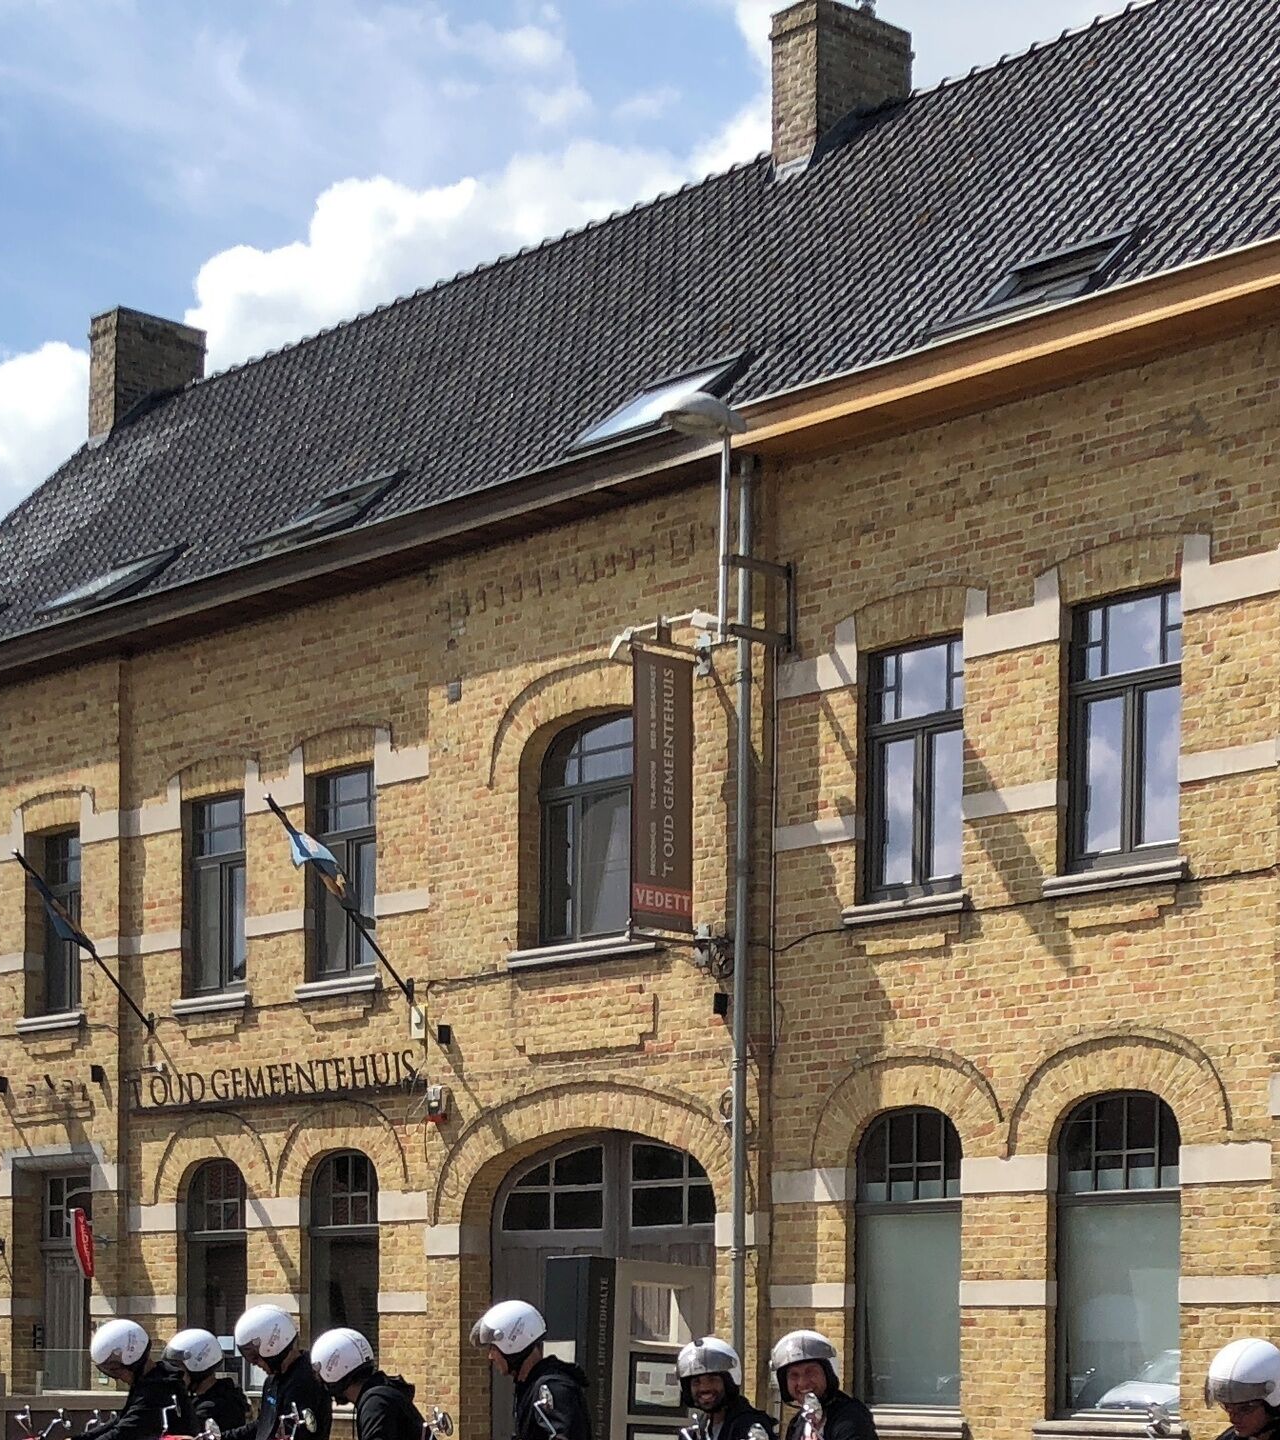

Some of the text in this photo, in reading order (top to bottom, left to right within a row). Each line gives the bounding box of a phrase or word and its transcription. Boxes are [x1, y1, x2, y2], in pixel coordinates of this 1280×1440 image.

[663, 666, 674, 810] GEMEENTEHUIS
[663, 815, 674, 858] OUD
[149, 1071, 206, 1107] OUD
[210, 1049, 419, 1102] GEMEENTEHUIS
